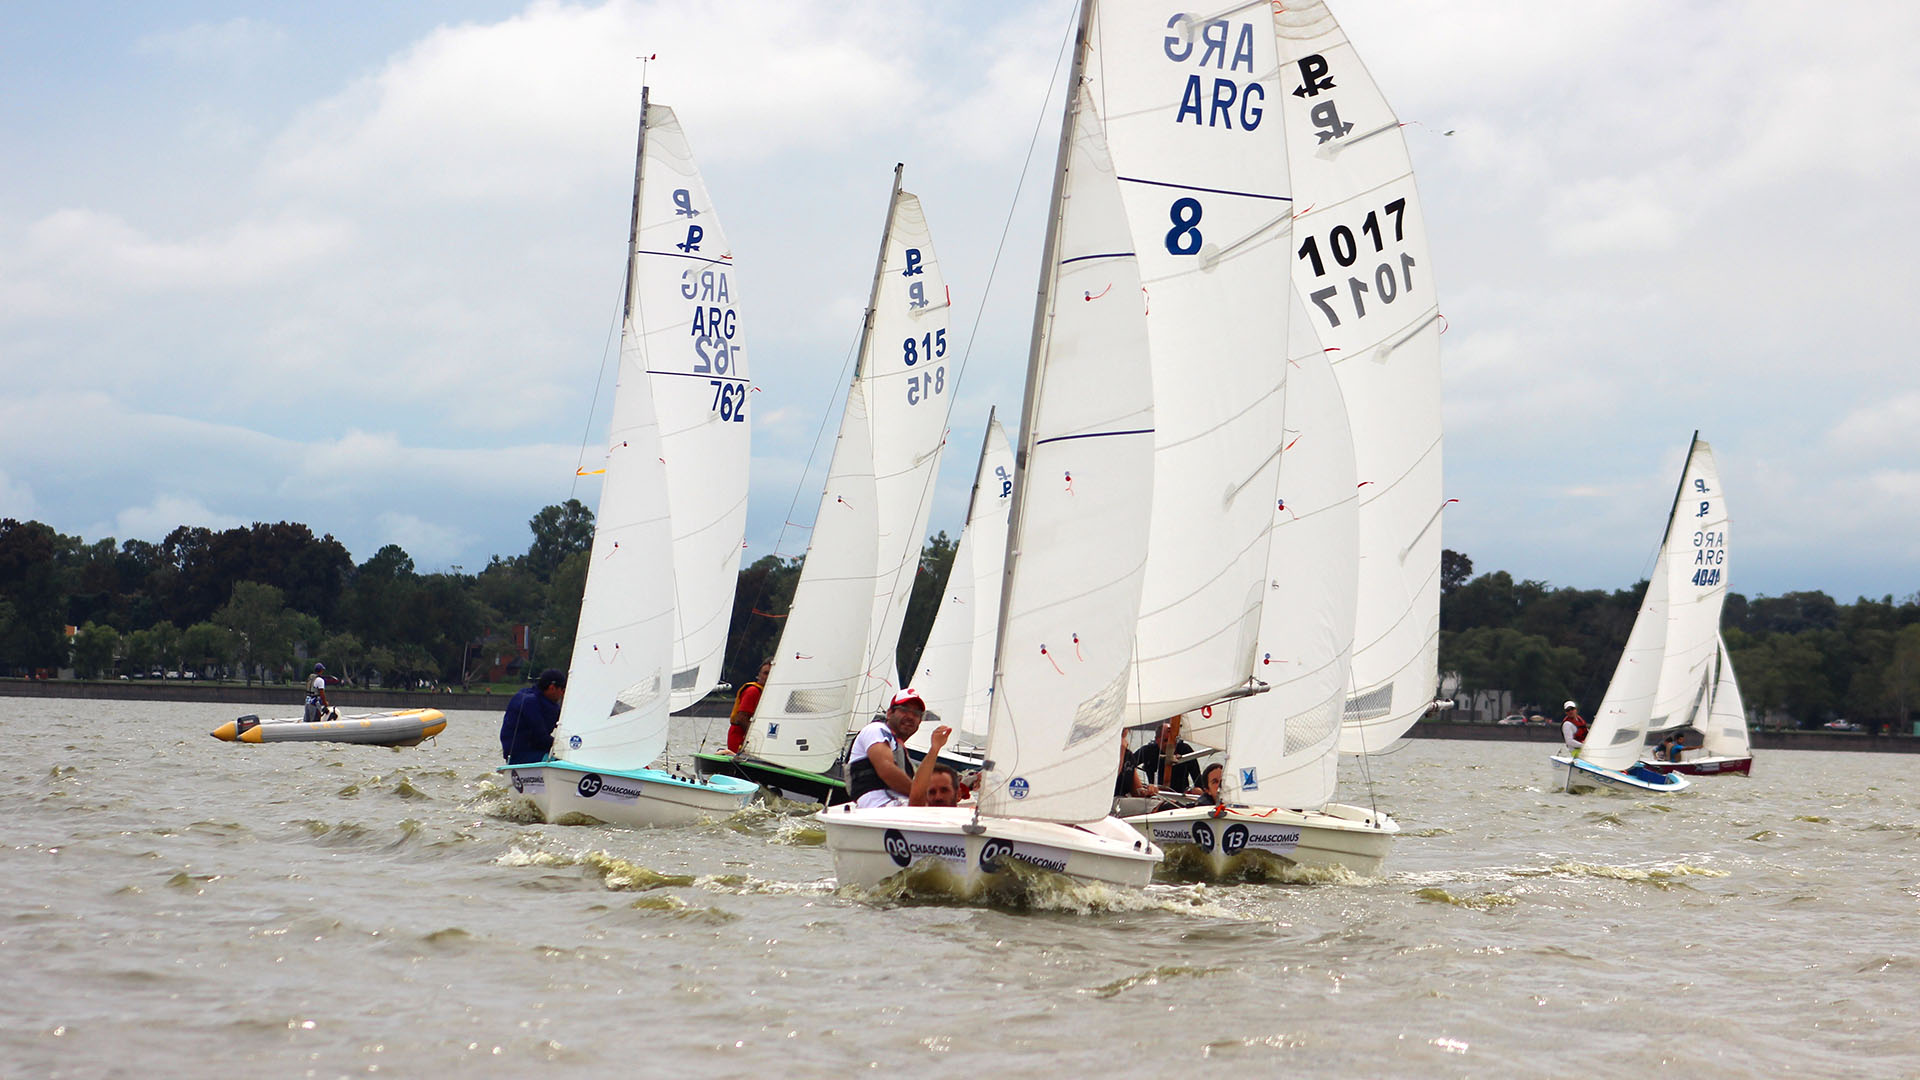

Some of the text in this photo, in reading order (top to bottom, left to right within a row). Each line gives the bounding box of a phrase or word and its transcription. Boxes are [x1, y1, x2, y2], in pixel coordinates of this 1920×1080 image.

[1176, 74, 1265, 132] ARG
[1165, 197, 1203, 255] 8
[1297, 197, 1406, 278] 1017
[691, 306, 737, 340] ARG
[903, 328, 946, 366] 815
[710, 381, 745, 422] 762
[1694, 549, 1724, 565] ARG
[580, 779, 600, 792] 05
[886, 837, 910, 859] 08
[909, 843, 966, 858] CHASCOMÚS
[1196, 829, 1211, 846] 13
[1227, 831, 1300, 848] 13 CHASCOMÚS
